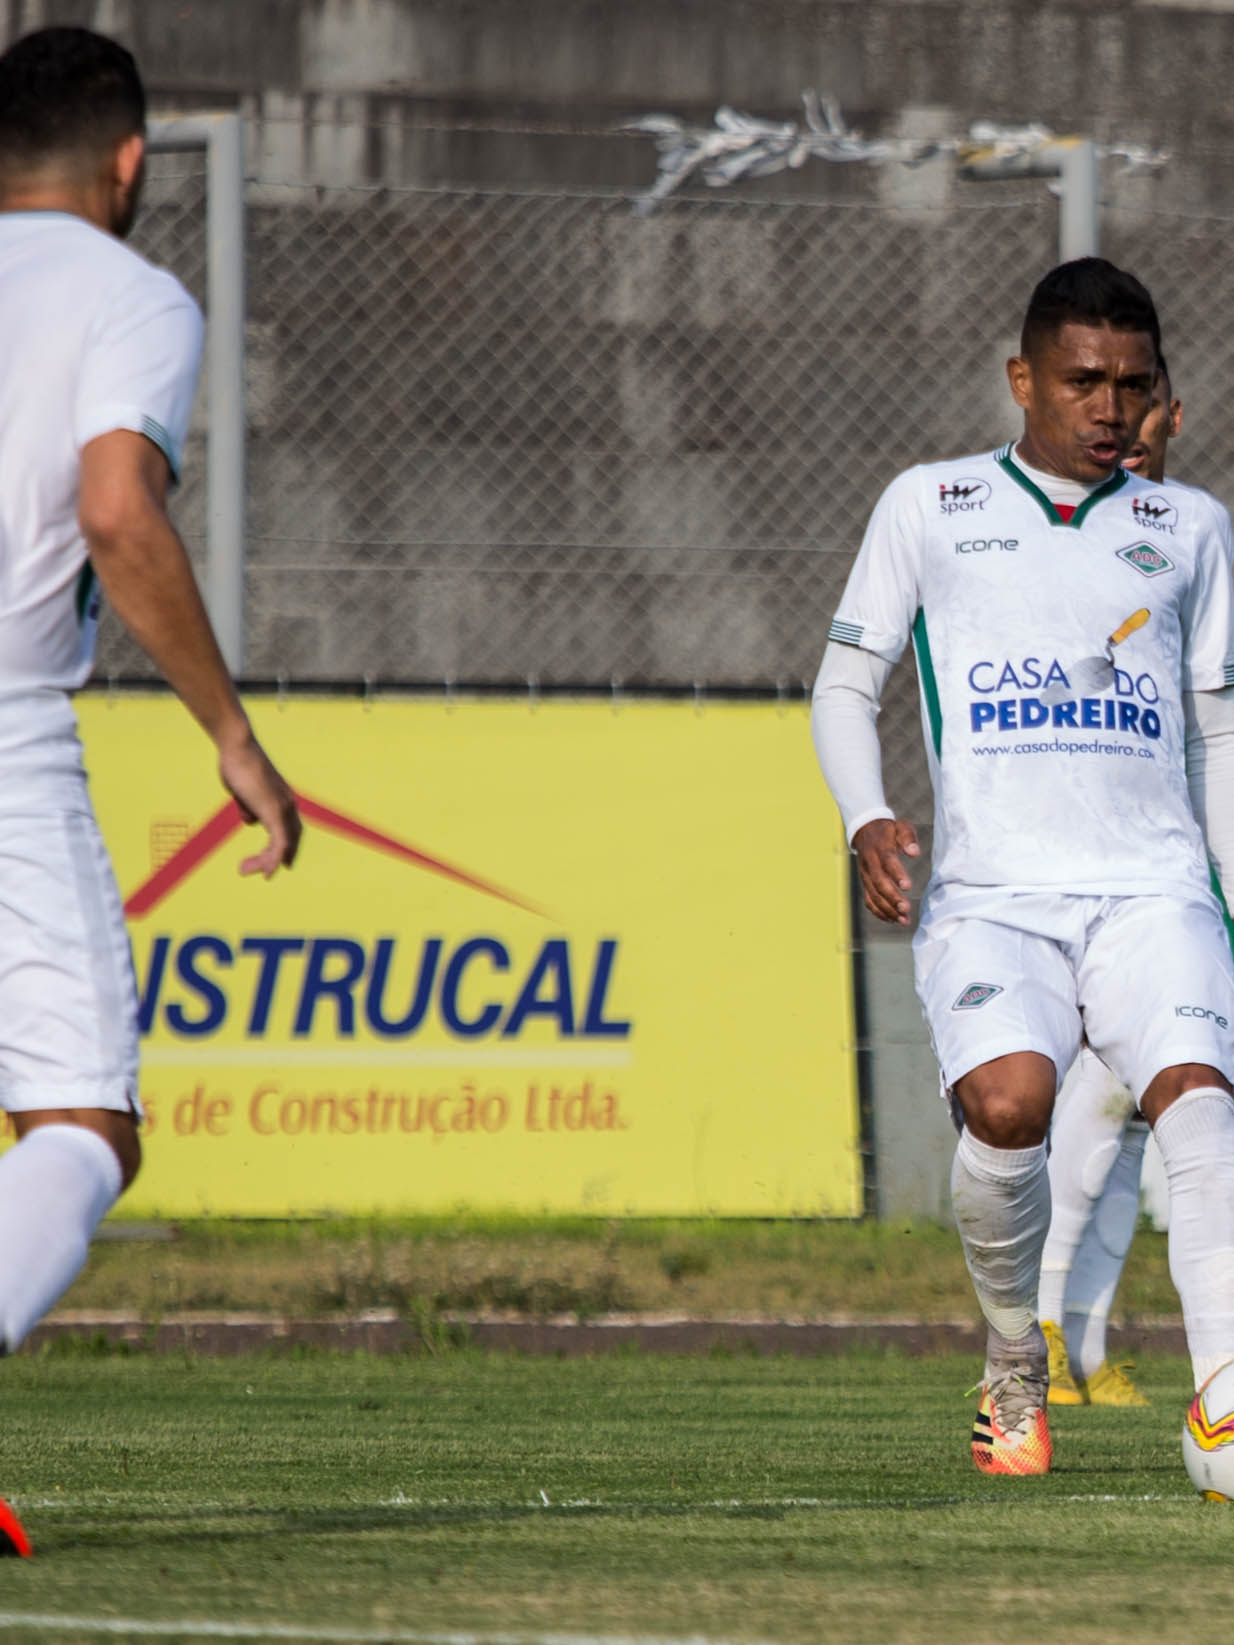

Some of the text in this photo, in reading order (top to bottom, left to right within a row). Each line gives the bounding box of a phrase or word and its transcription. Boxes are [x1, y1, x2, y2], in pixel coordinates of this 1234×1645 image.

[940, 500, 985, 517] sport
[1134, 516, 1175, 535] sport
[967, 657, 1160, 704] CASA DO
[969, 697, 1162, 740] PEDREIRO
[173, 1080, 232, 1136] de
[248, 1079, 511, 1143] Construção
[524, 1079, 632, 1133] Ltda.
